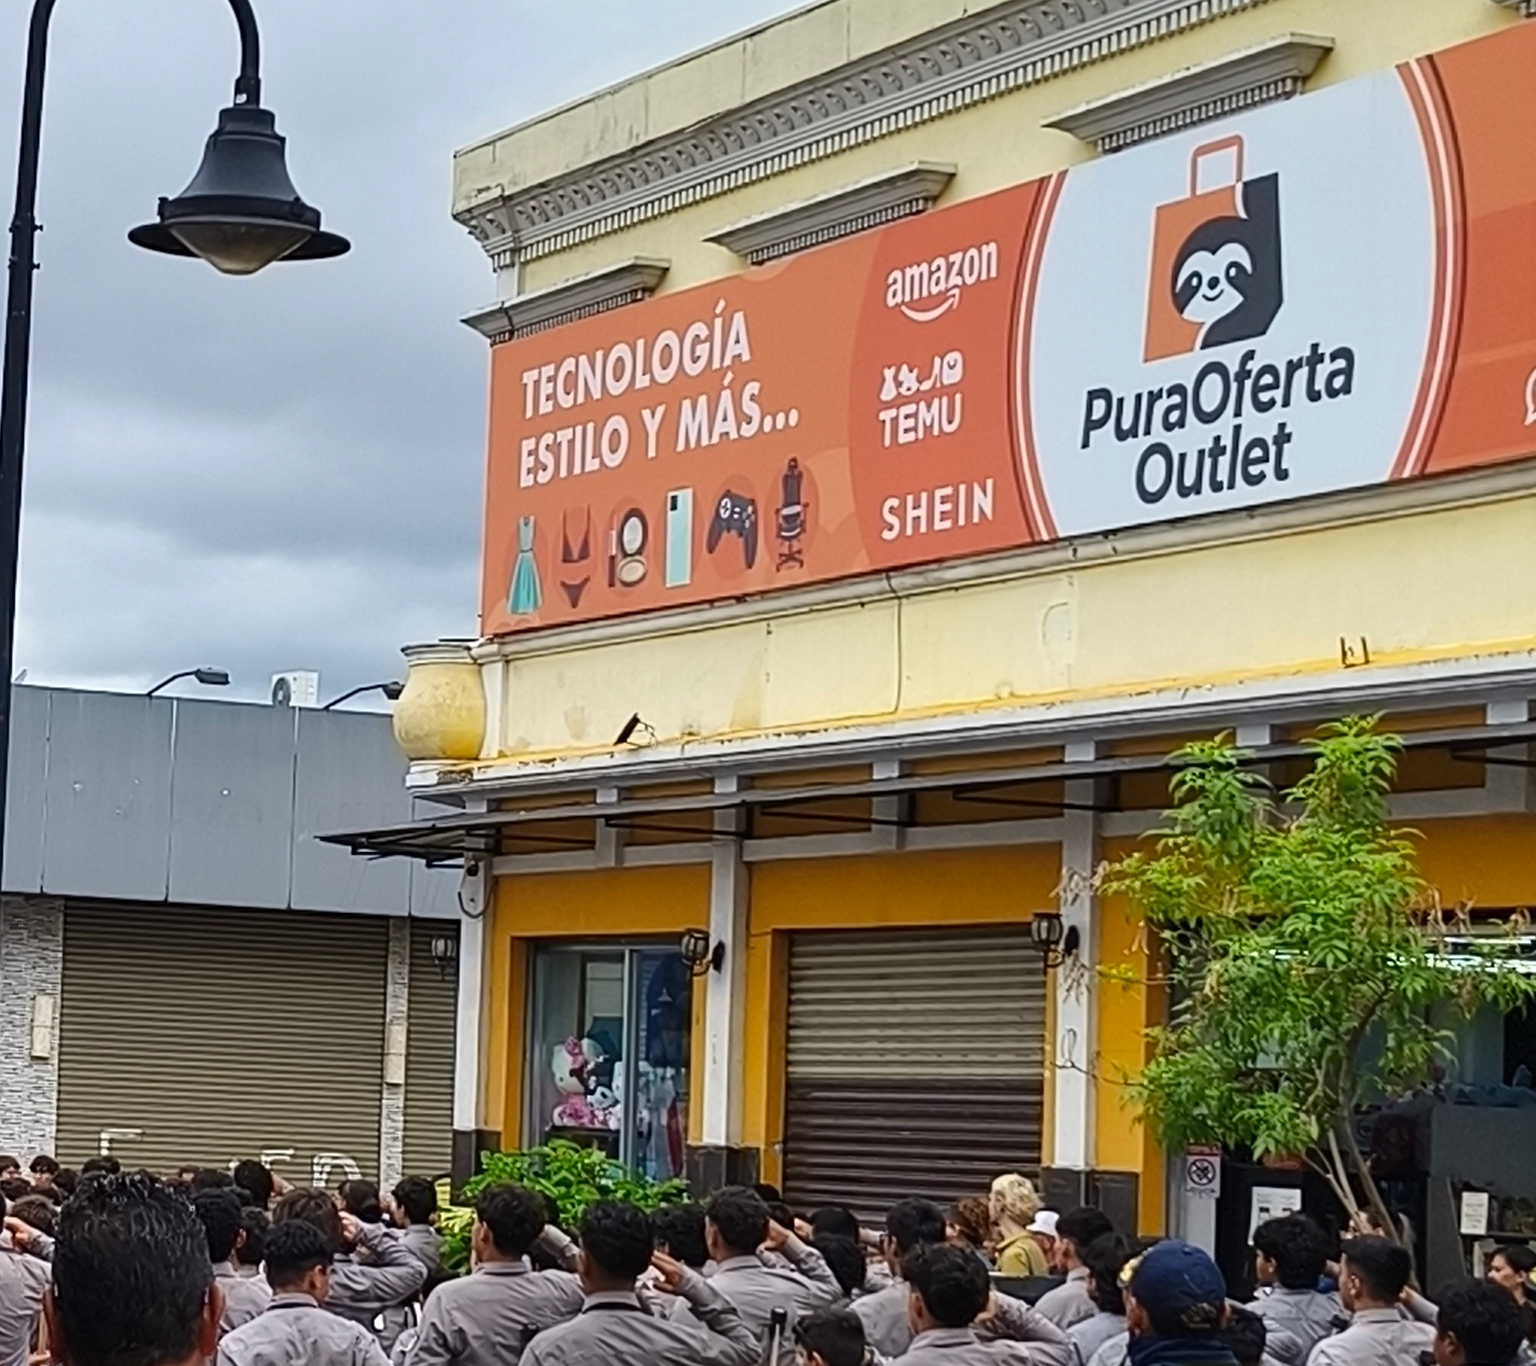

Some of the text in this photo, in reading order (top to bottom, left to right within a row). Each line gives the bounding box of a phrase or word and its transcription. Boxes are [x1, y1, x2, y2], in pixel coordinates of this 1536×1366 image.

[885, 241, 998, 309] amazon
[521, 298, 751, 419] TECNOLOGÍA
[1080, 342, 1355, 450] PuraOferta
[519, 371, 799, 489] ESTILO Y MÁS...
[879, 392, 962, 447] TEMU
[1135, 422, 1293, 505] Outlet
[880, 478, 994, 541] SHEIN
